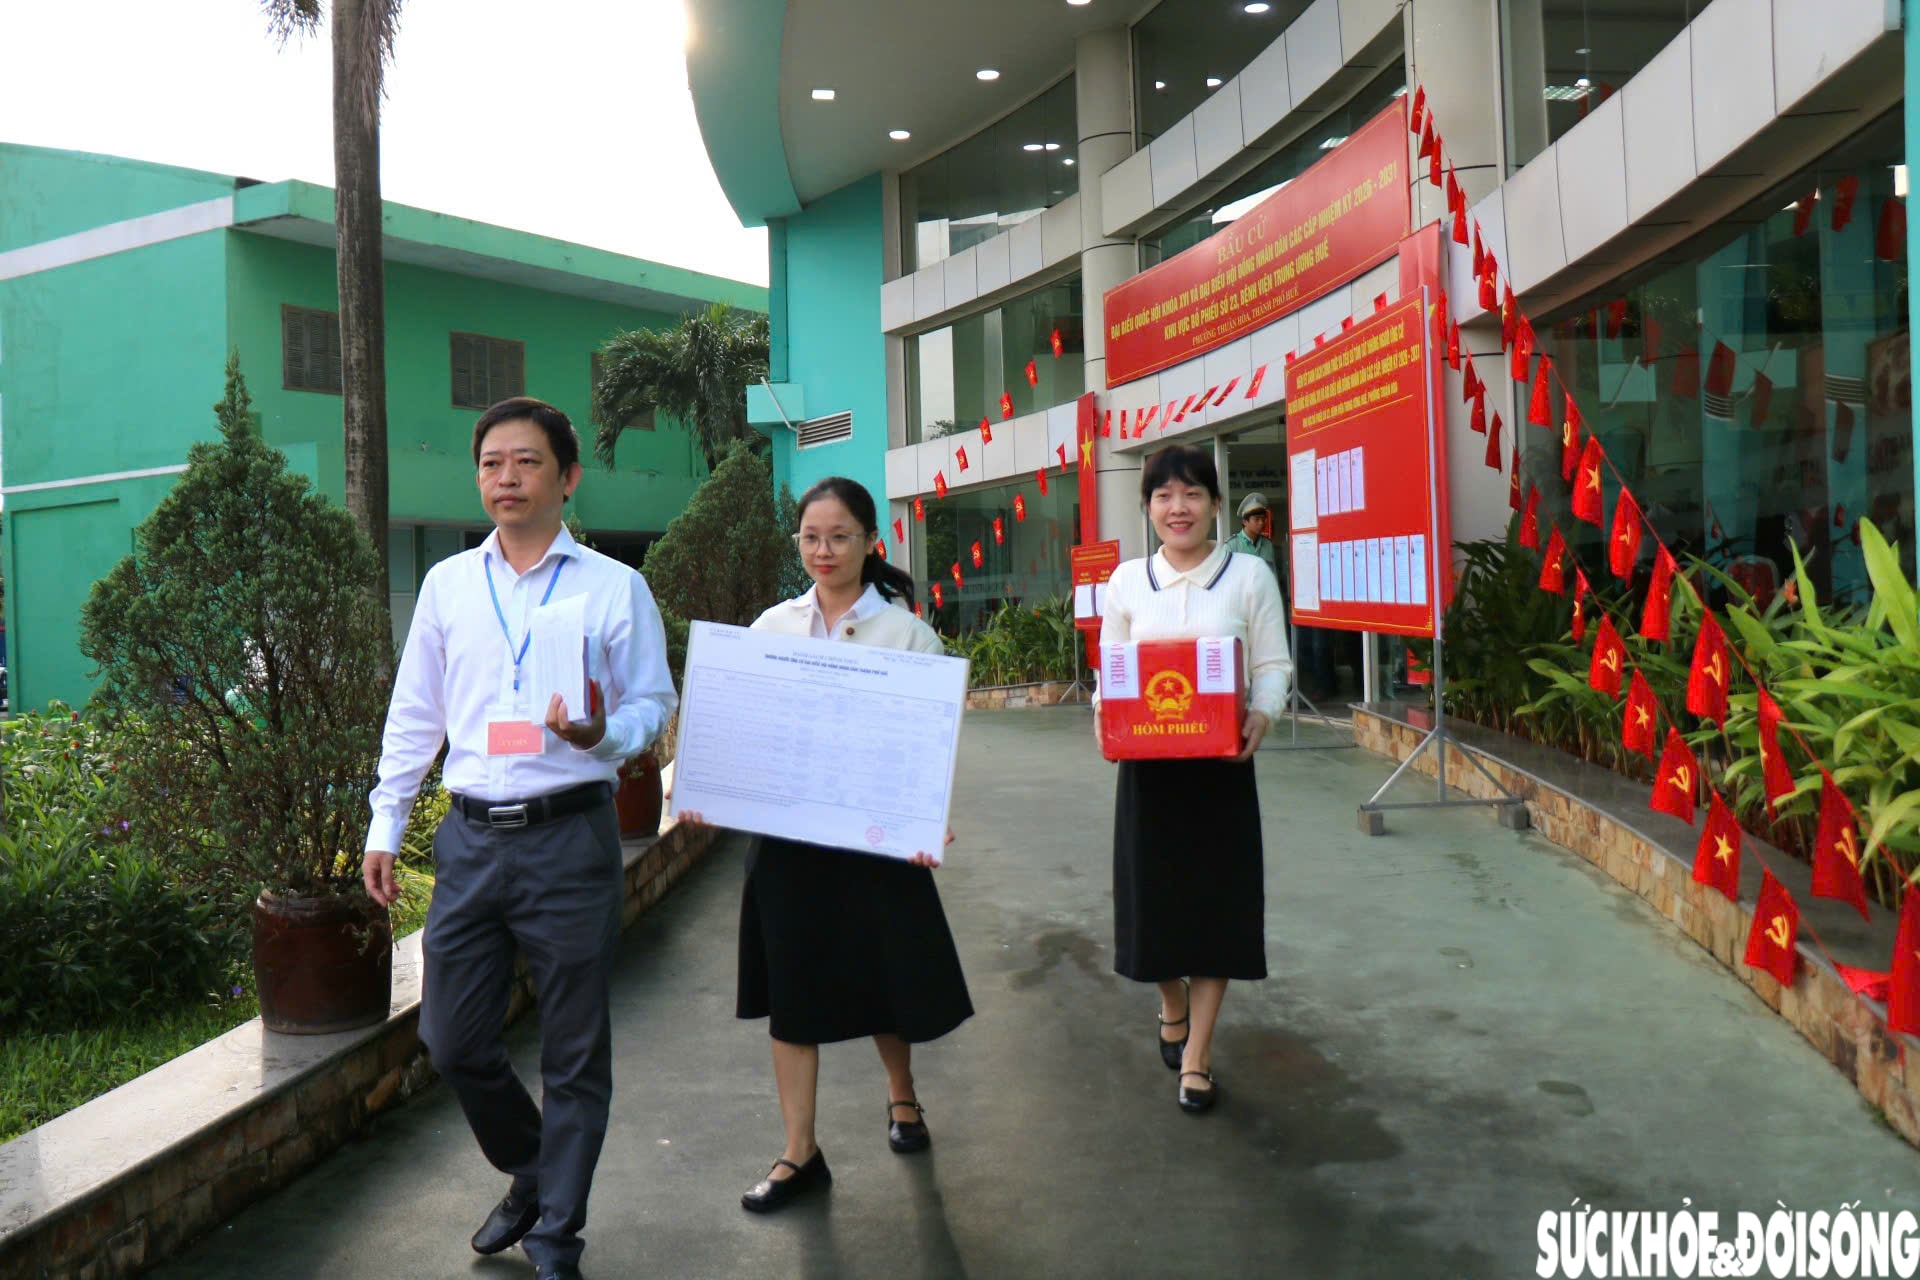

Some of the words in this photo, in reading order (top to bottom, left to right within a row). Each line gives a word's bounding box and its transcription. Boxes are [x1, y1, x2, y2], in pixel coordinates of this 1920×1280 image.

[1134, 306, 1150, 330] QUỐC
[1151, 303, 1161, 323] HỘI
[1179, 290, 1189, 309] XVI
[1190, 284, 1199, 303] VÀ
[1200, 280, 1210, 301] ĐẠI
[1226, 264, 1237, 287] HỘI
[1256, 244, 1274, 269] NHÂN
[1274, 234, 1288, 258] DÂN
[1289, 225, 1302, 248] CÁC
[1304, 213, 1317, 239] CẤP
[1318, 200, 1341, 230] NHIỆM
[1353, 179, 1373, 207] 2026
[1378, 160, 1397, 190] 2031
[1217, 231, 1243, 264] BẦU
[1248, 214, 1267, 245] CỬ
[1164, 322, 1177, 341] KHU
[1200, 299, 1219, 325] PHIẾU
[1220, 292, 1228, 316] SỐ
[1240, 284, 1257, 307] BỆNH
[1258, 273, 1273, 296] VIỆN
[1273, 261, 1295, 287] TRUNG
[1314, 233, 1329, 263] HUẾ
[1132, 722, 1165, 736] HÒM
[1168, 720, 1209, 735] PHIẾU
